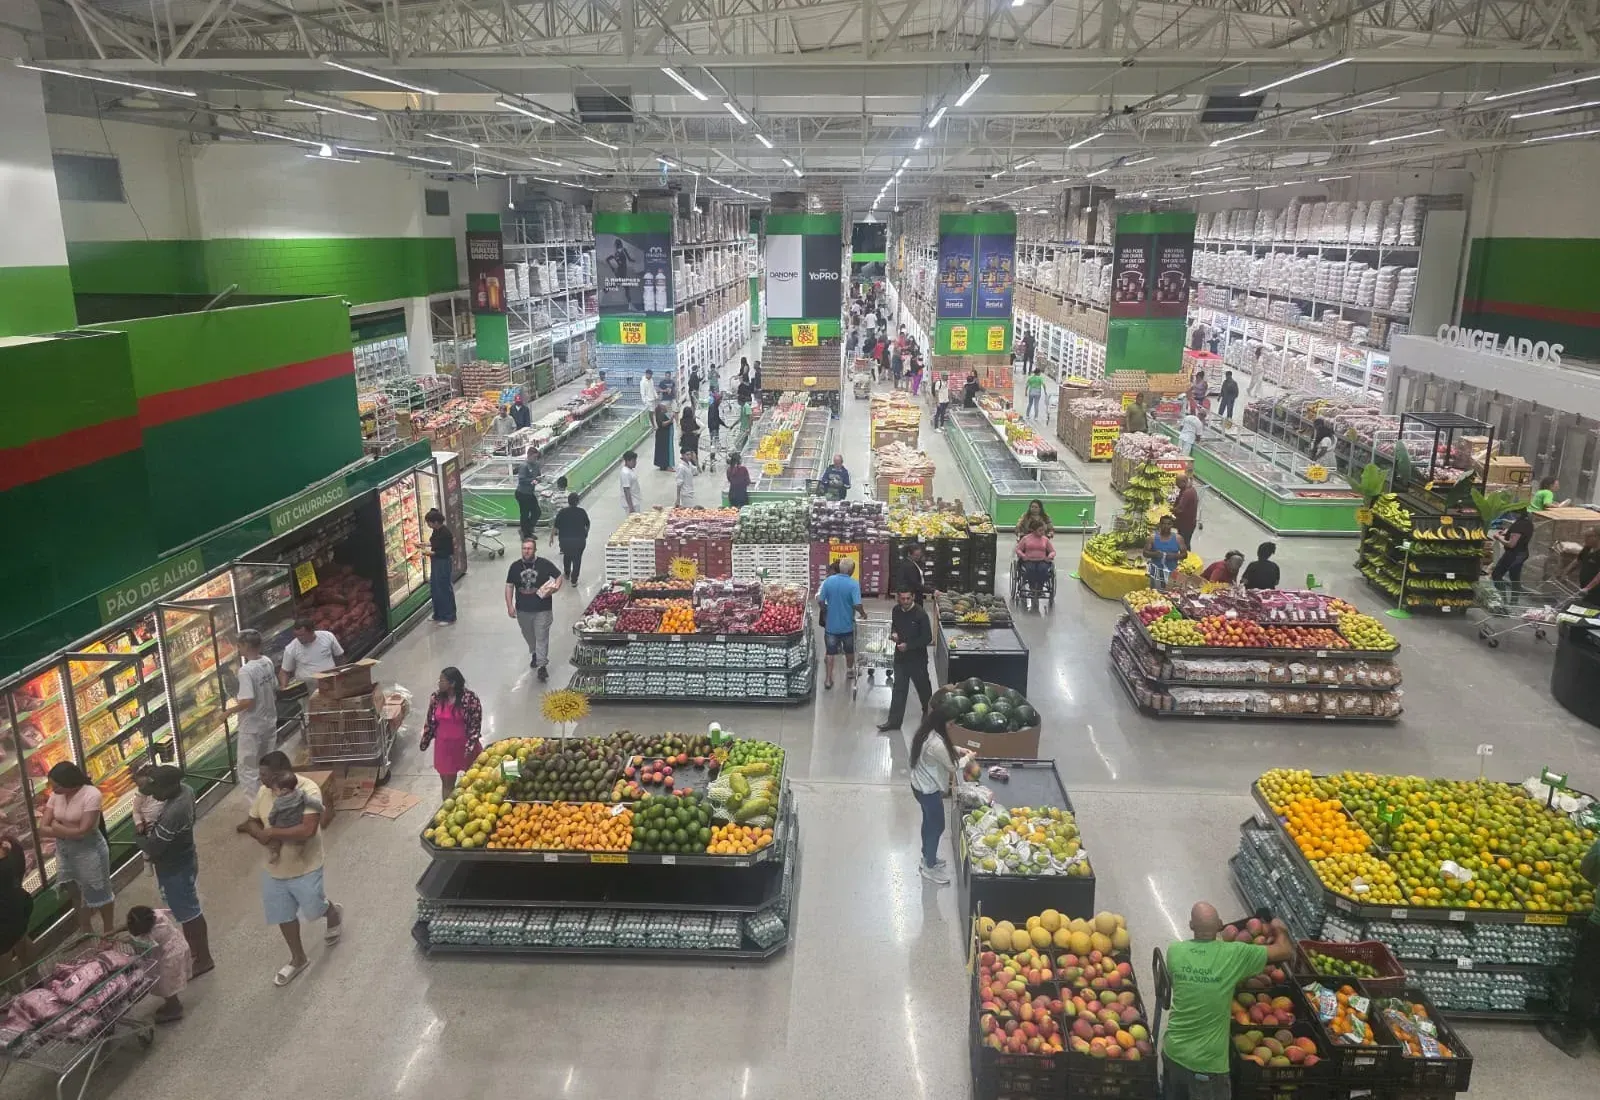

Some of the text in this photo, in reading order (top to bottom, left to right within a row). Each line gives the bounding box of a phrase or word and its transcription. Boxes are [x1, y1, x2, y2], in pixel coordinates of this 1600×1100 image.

[769, 271, 799, 279] DANONE
[808, 271, 839, 281] YoPRO
[1437, 324, 1564, 367] CONGELADOS
[276, 486, 344, 529] KIT CHURRASCO
[105, 558, 199, 617] PÃO DE ALHO
